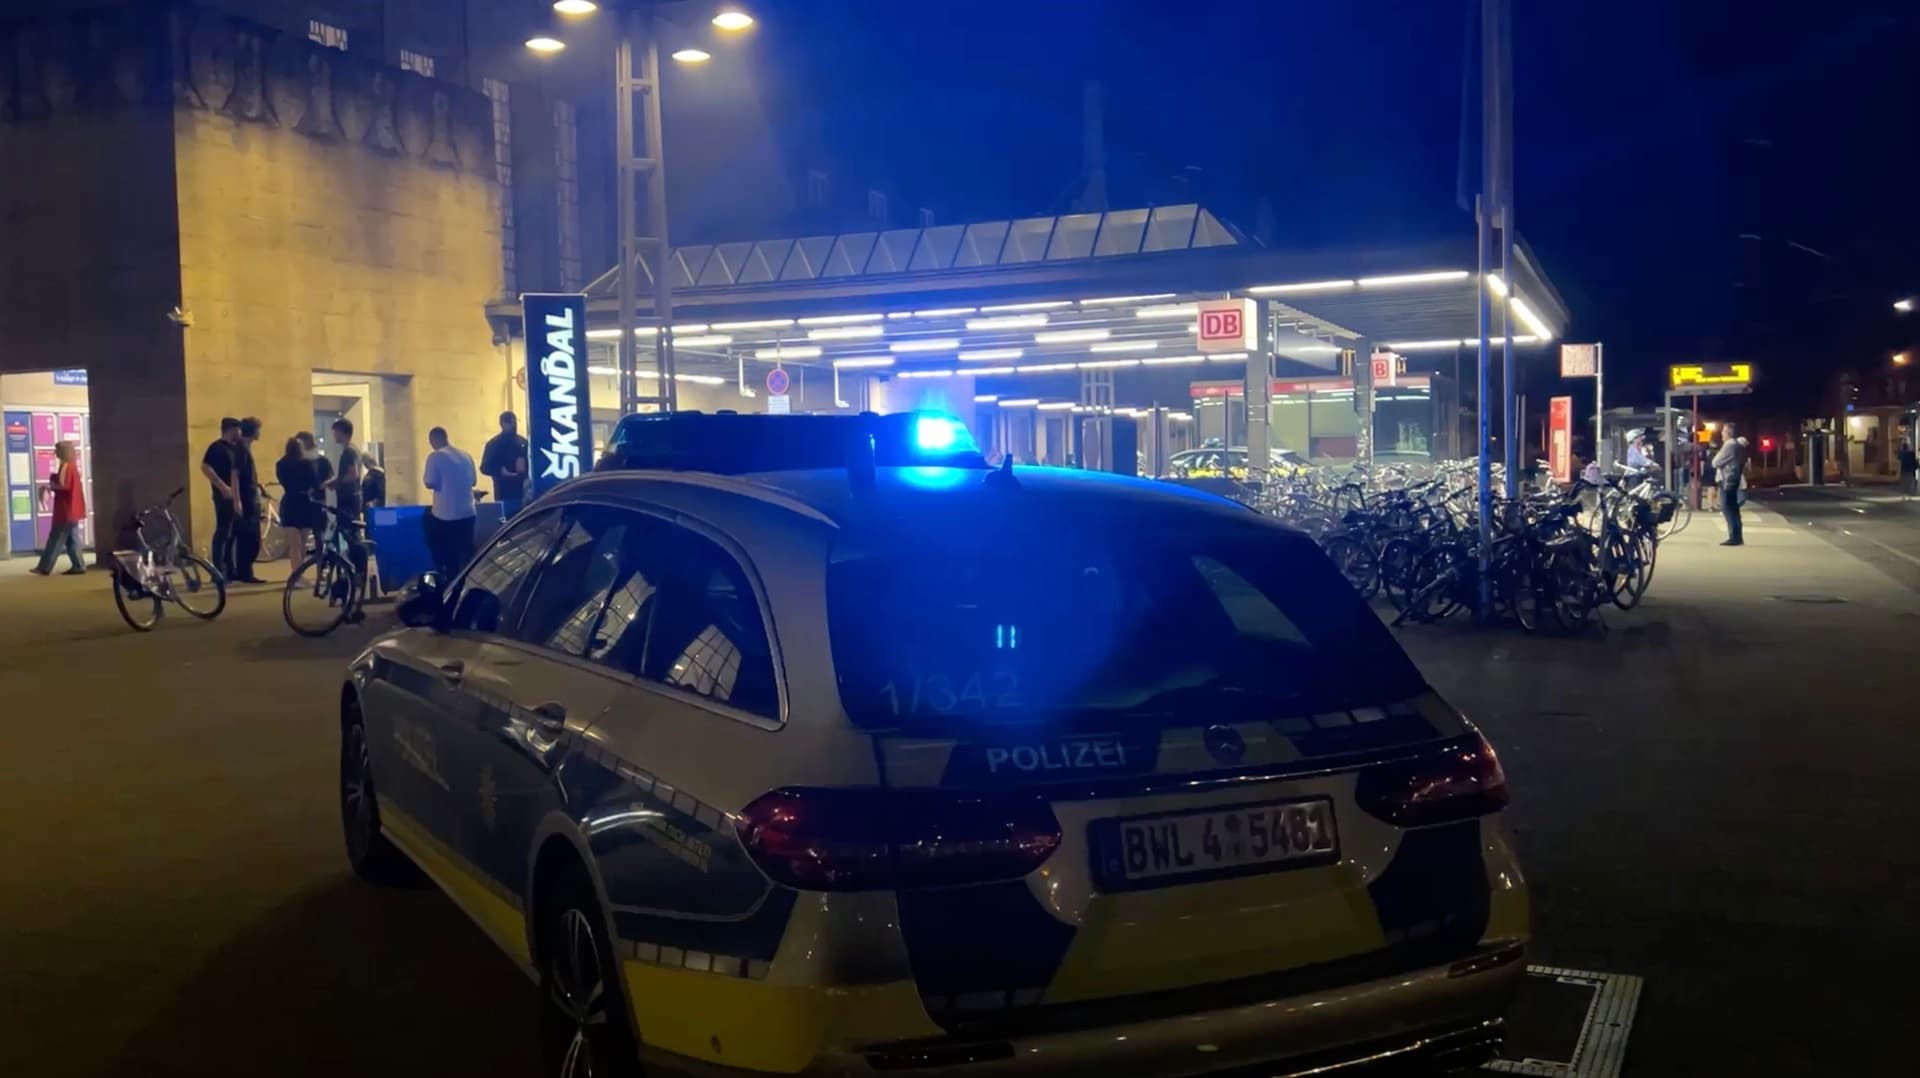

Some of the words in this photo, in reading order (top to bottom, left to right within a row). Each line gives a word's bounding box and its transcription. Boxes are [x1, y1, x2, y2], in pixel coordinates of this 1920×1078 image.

[1206, 315, 1238, 336] DB
[541, 307, 580, 480] SKANDAL
[986, 740, 1127, 774] POLIZEI
[1125, 823, 1194, 873] BWL
